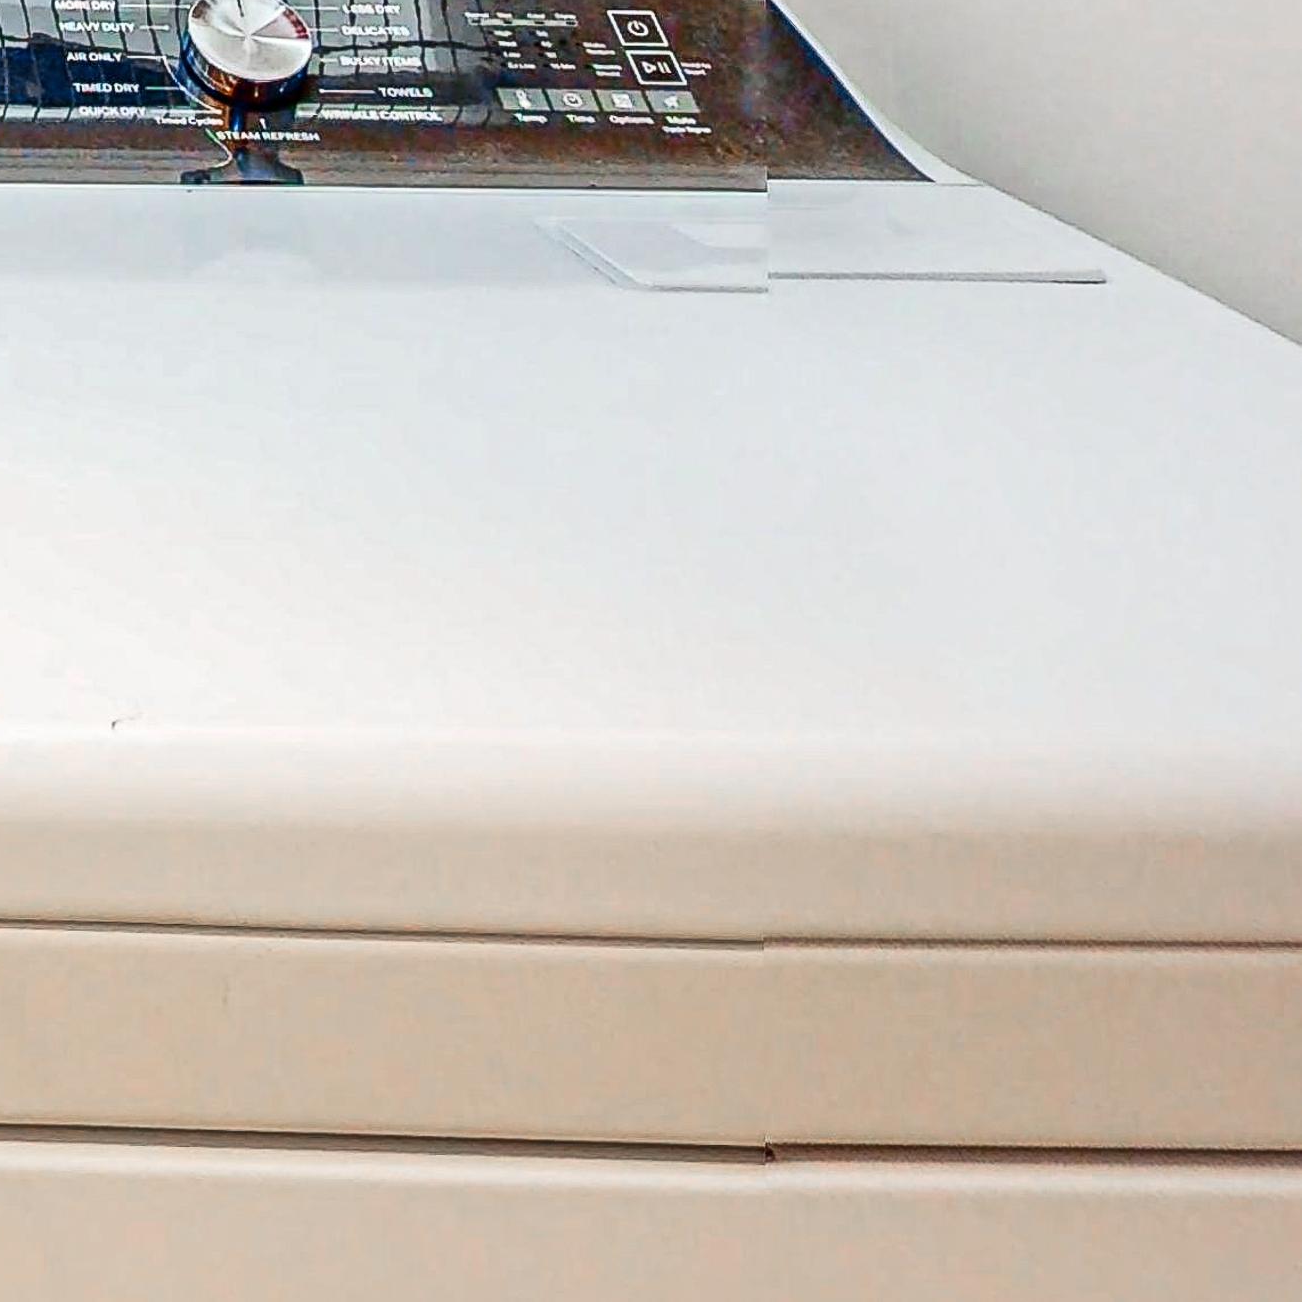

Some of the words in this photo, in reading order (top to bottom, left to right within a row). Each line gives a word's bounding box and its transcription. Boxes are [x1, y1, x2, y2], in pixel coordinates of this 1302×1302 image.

[55, 0, 90, 10] MORE
[91, 0, 115, 10] DRY
[59, 22, 100, 32] HEAVY
[101, 22, 134, 32] DUTY
[341, 26, 410, 36] DELICATES
[66, 51, 87, 62] AIR
[88, 51, 122, 62] ONLY
[340, 56, 378, 66] BULKY
[72, 82, 113, 93] TIMED
[114, 83, 140, 93] DRY
[377, 87, 434, 98] TOWELS
[119, 106, 147, 117] DRY
[380, 111, 444, 122] CONTROL
[216, 131, 261, 141] STEAM
[262, 131, 321, 141] REFRESH
